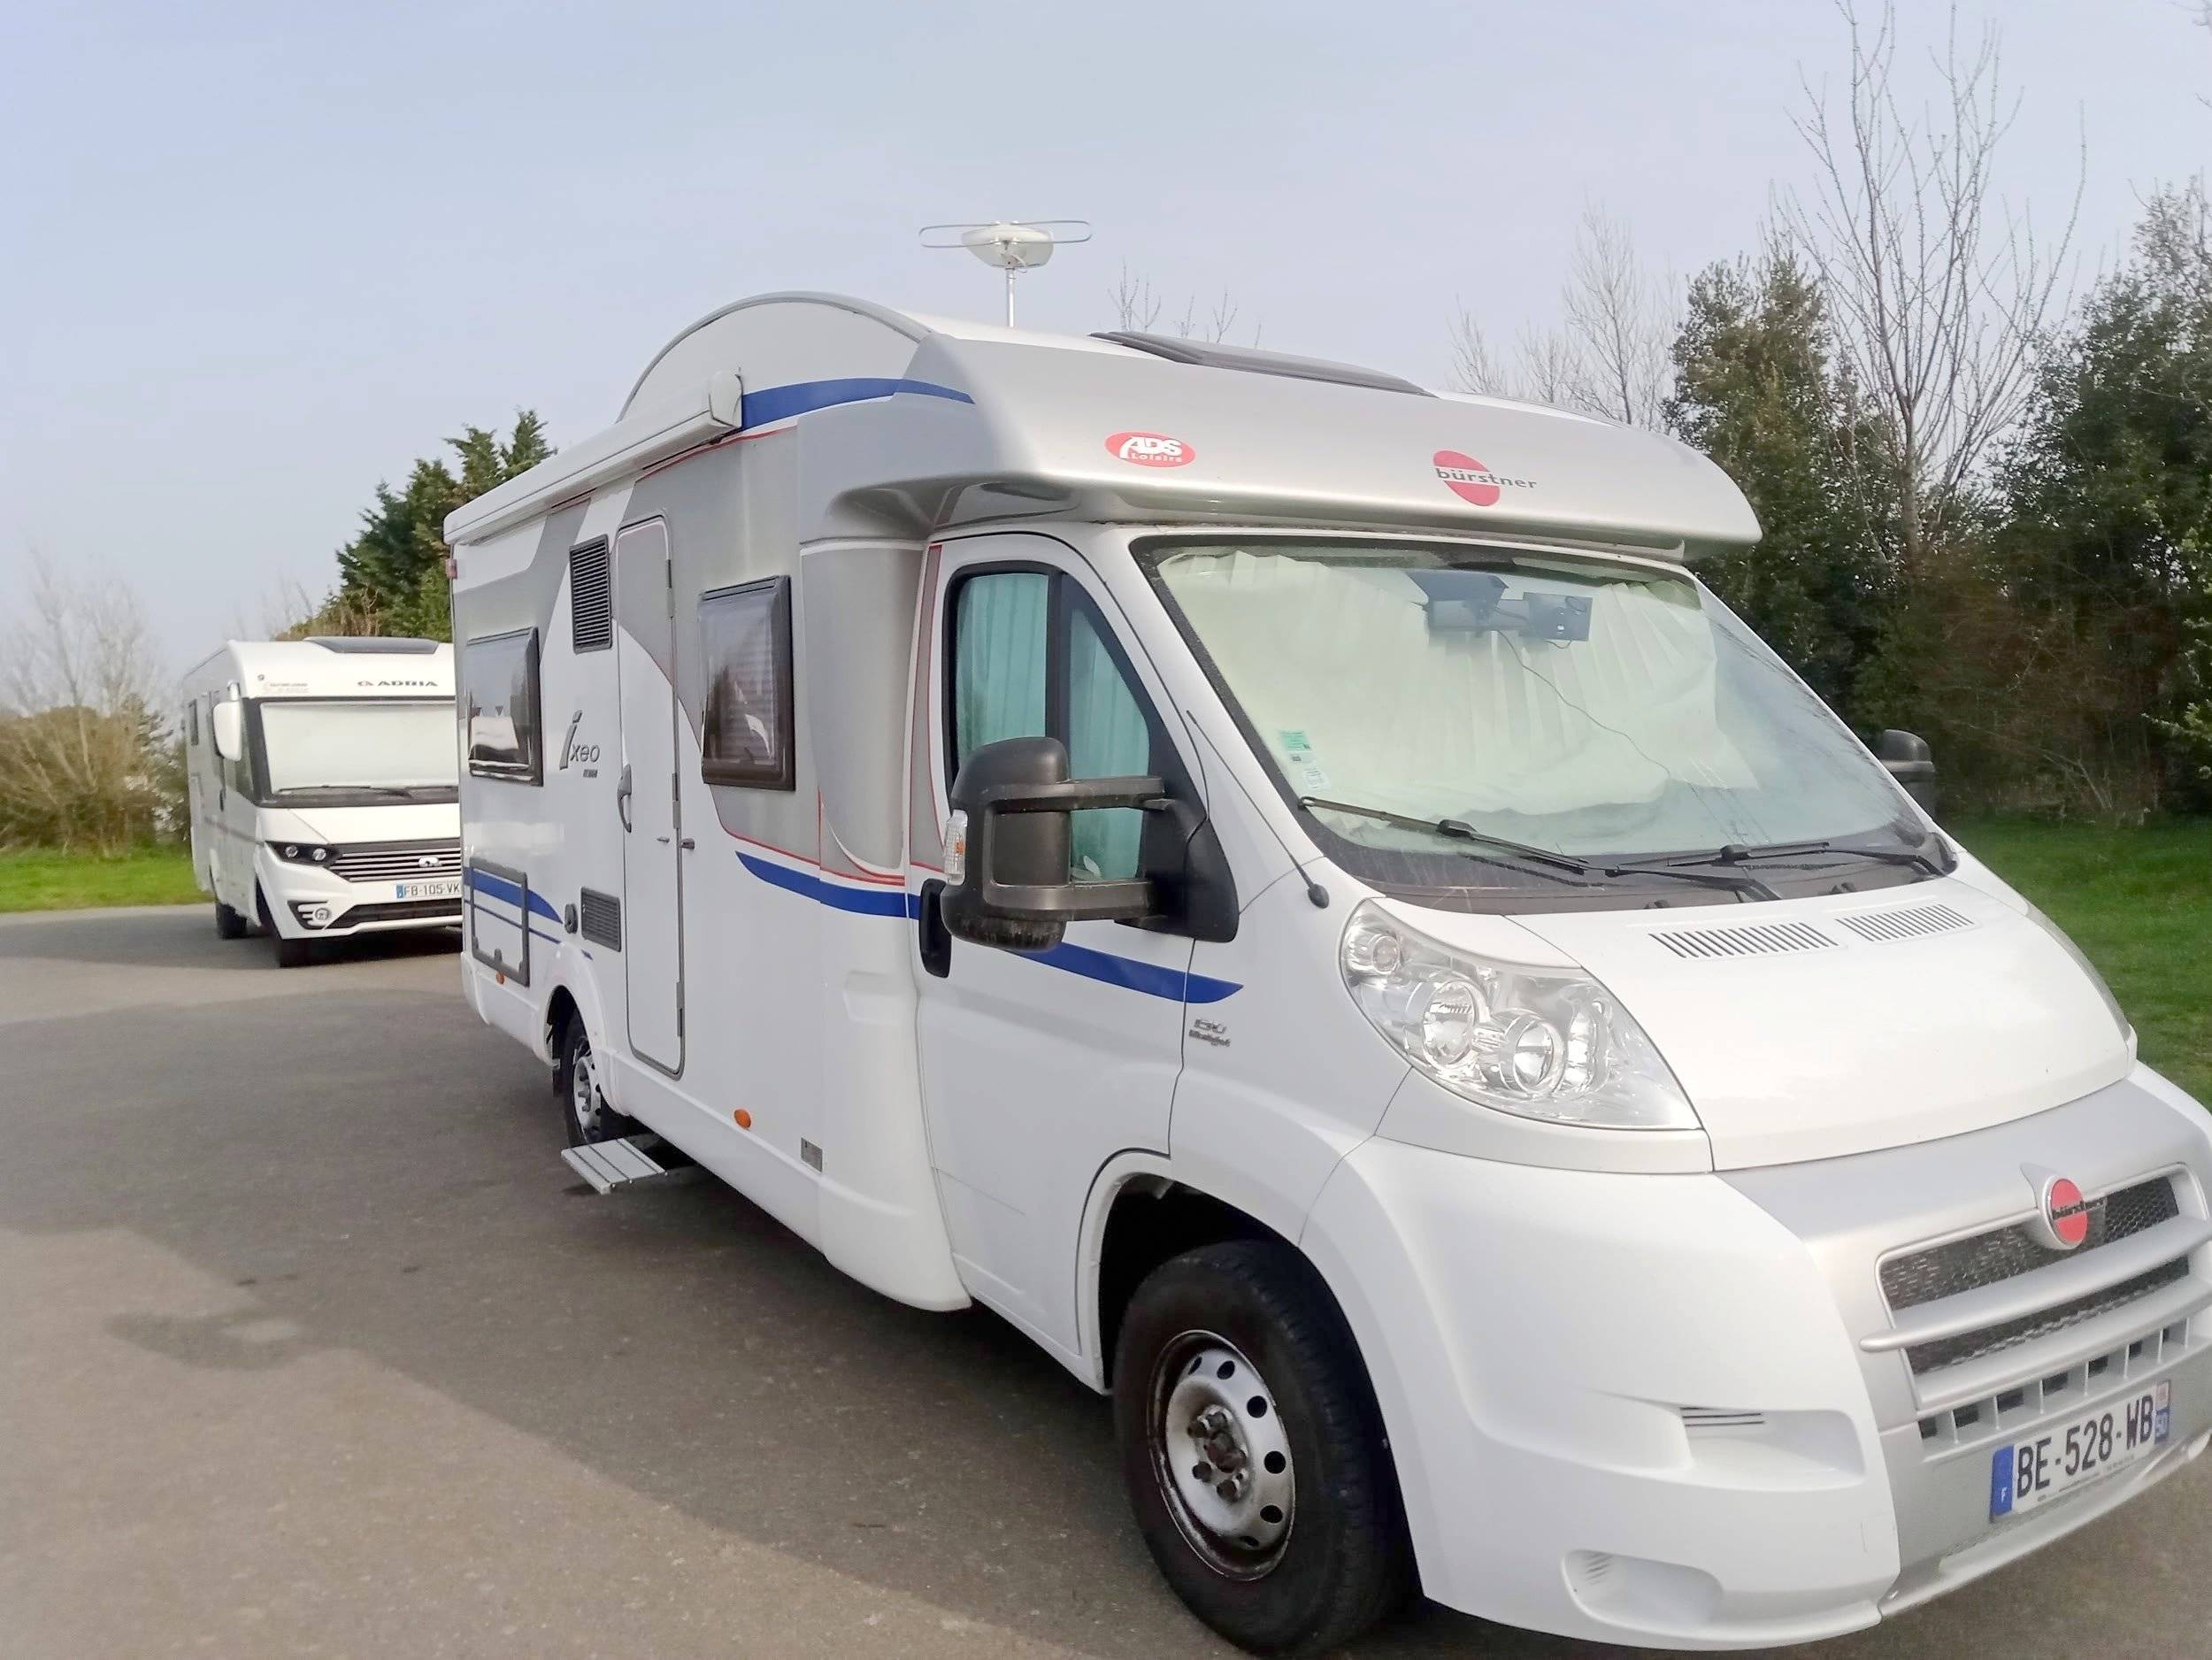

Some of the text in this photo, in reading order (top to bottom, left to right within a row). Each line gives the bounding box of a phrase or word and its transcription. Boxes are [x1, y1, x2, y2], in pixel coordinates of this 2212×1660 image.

[1118, 436, 1183, 459] ADS
[1435, 467, 1537, 488] bürstner
[404, 882, 460, 897] FB-105-VK
[2016, 1395, 2154, 1499] BE-528-WB
